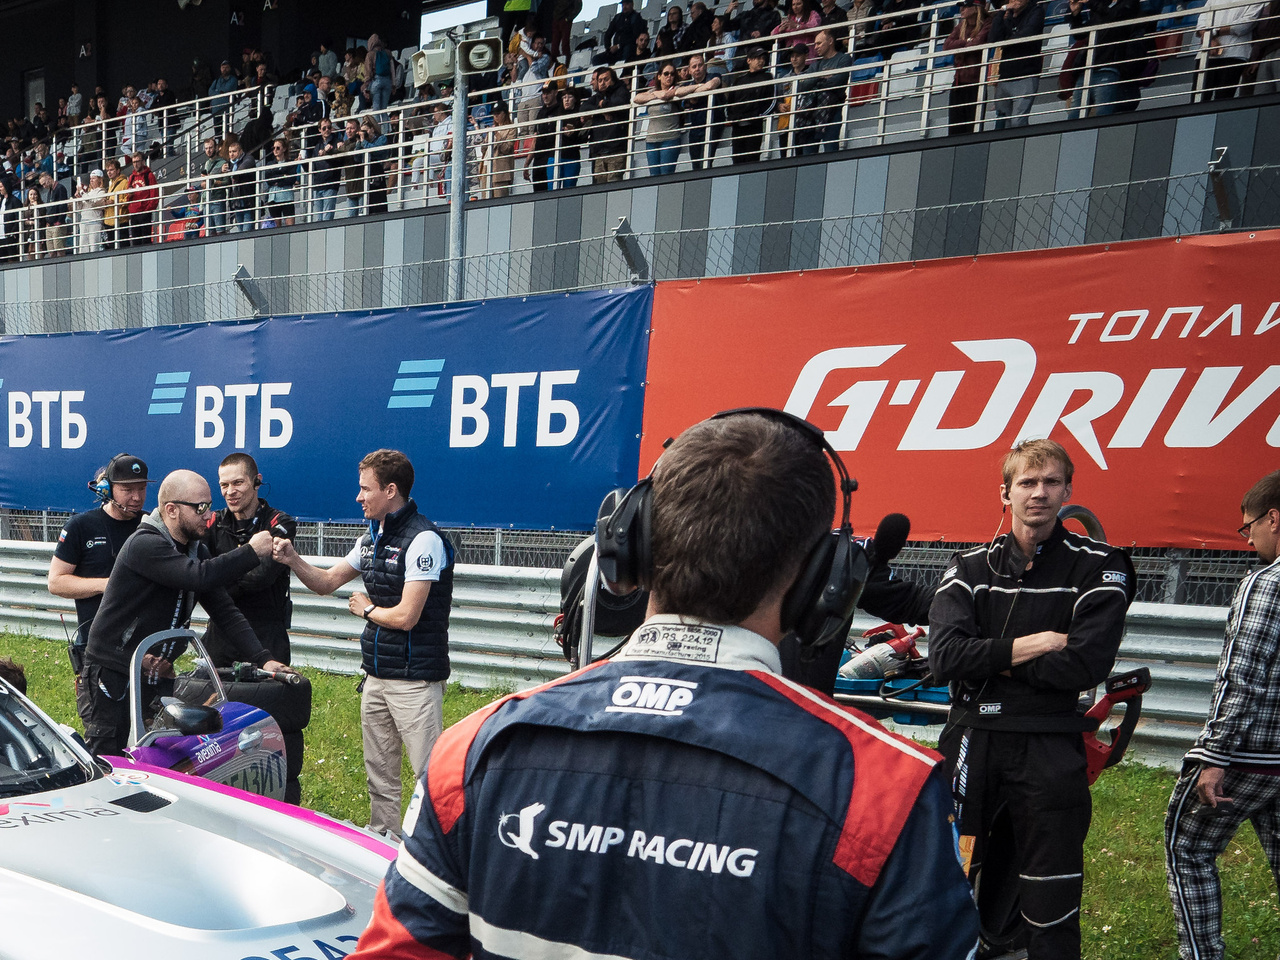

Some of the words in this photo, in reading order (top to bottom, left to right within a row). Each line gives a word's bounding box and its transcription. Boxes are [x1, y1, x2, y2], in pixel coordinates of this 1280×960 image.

[7, 390, 88, 449] ВТБ
[195, 382, 293, 449] ВТБ
[449, 369, 580, 448] ВТБ
[783, 338, 1280, 471] G-DRIV
[1102, 573, 1127, 583] OMP
[612, 683, 694, 711] OMP
[979, 705, 1002, 714] OMP
[195, 741, 222, 763] avexima
[545, 820, 625, 854] SMP
[627, 830, 758, 877] RACING
